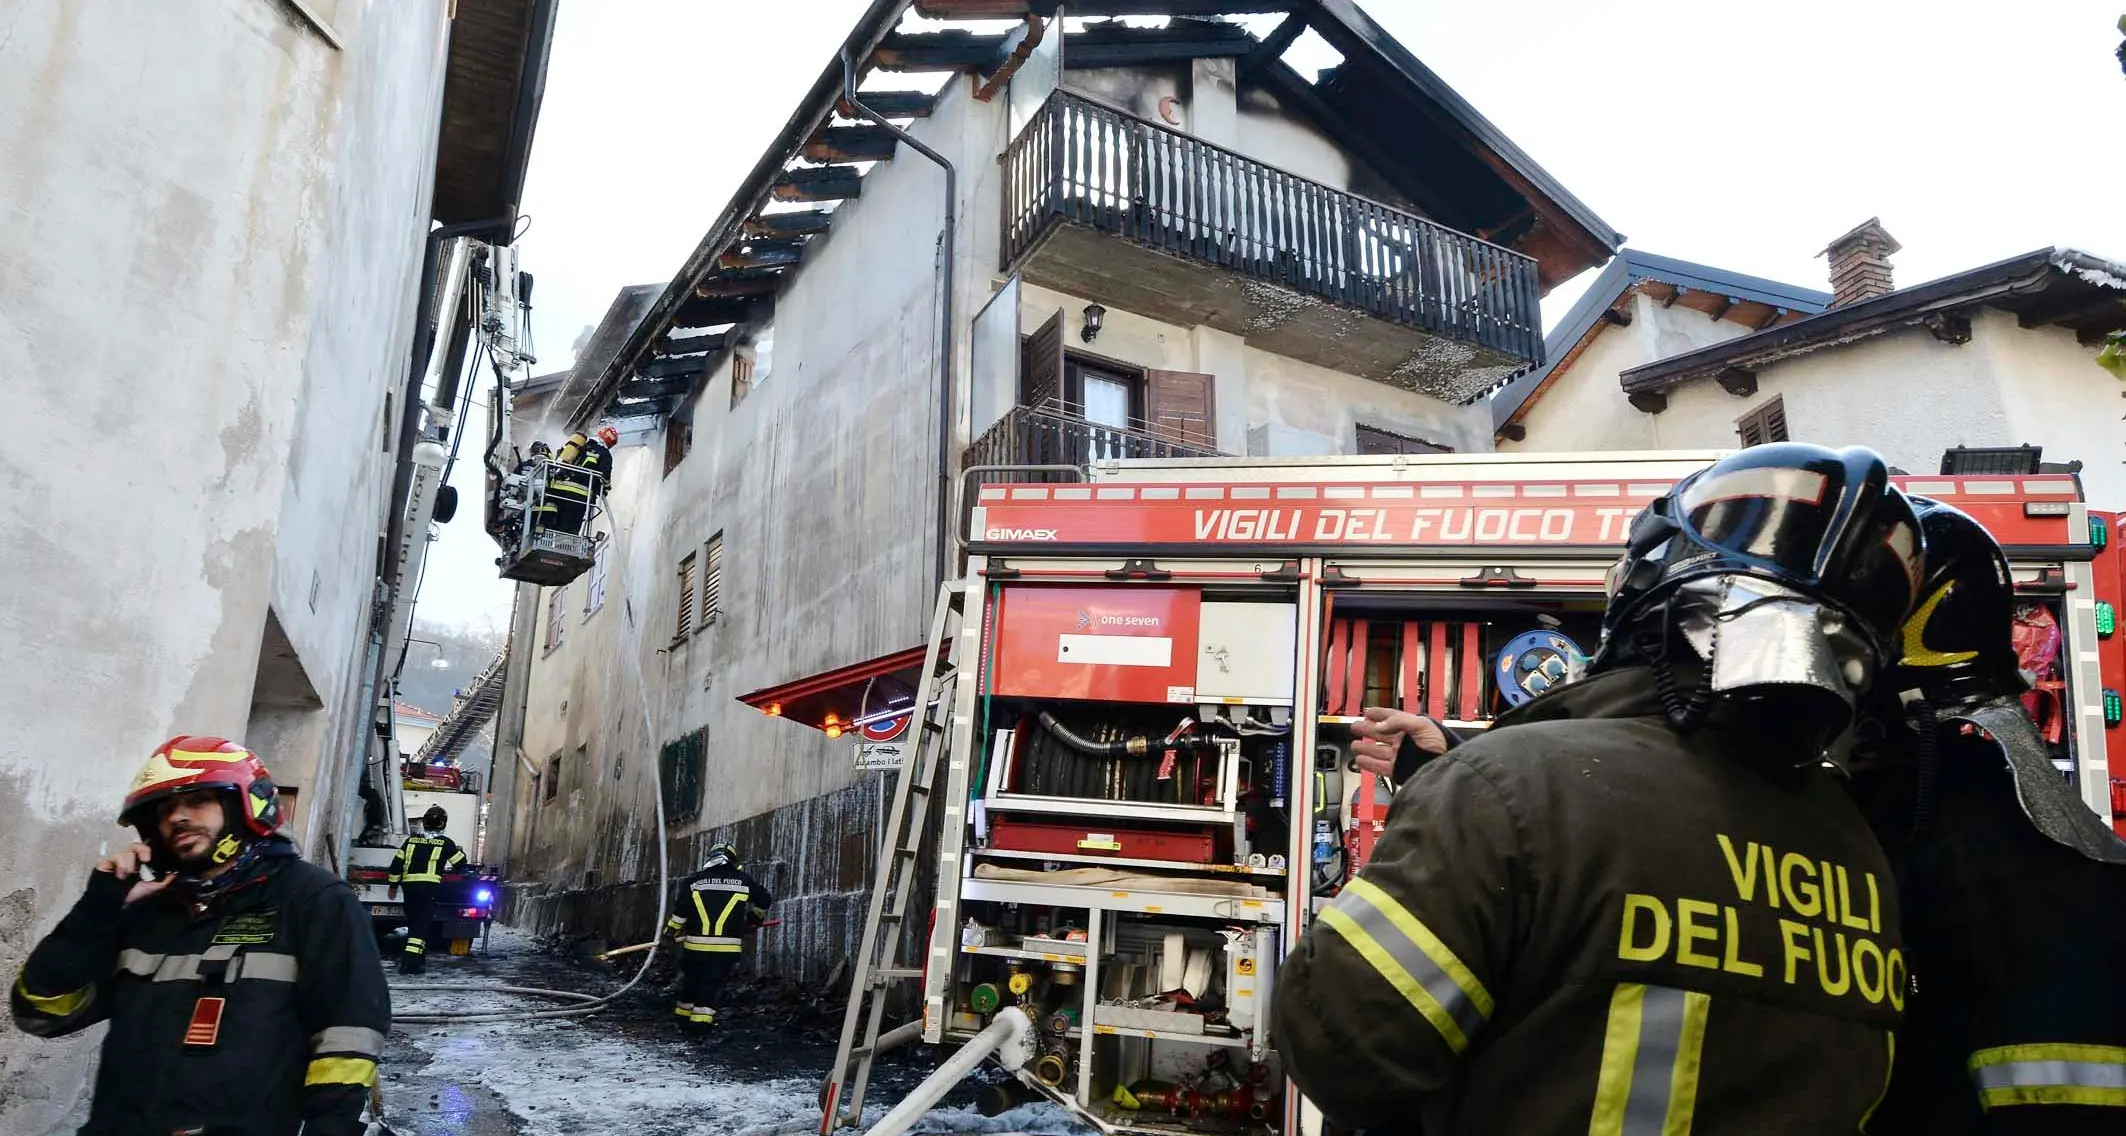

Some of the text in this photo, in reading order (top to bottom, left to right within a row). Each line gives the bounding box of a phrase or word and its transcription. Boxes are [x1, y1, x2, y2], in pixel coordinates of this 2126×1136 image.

[1195, 509, 1302, 540] VIGILI
[1313, 509, 1393, 540] DEL
[1410, 508, 1575, 541] FUOCO
[986, 528, 1058, 540] GIMAEX
[1255, 564, 1262, 574] 6
[1101, 616, 1159, 626] one seven
[723, 878, 743, 886] FUOCO
[1716, 834, 1881, 933] VIGILI
[1618, 894, 1907, 1012] DEL FUOC
